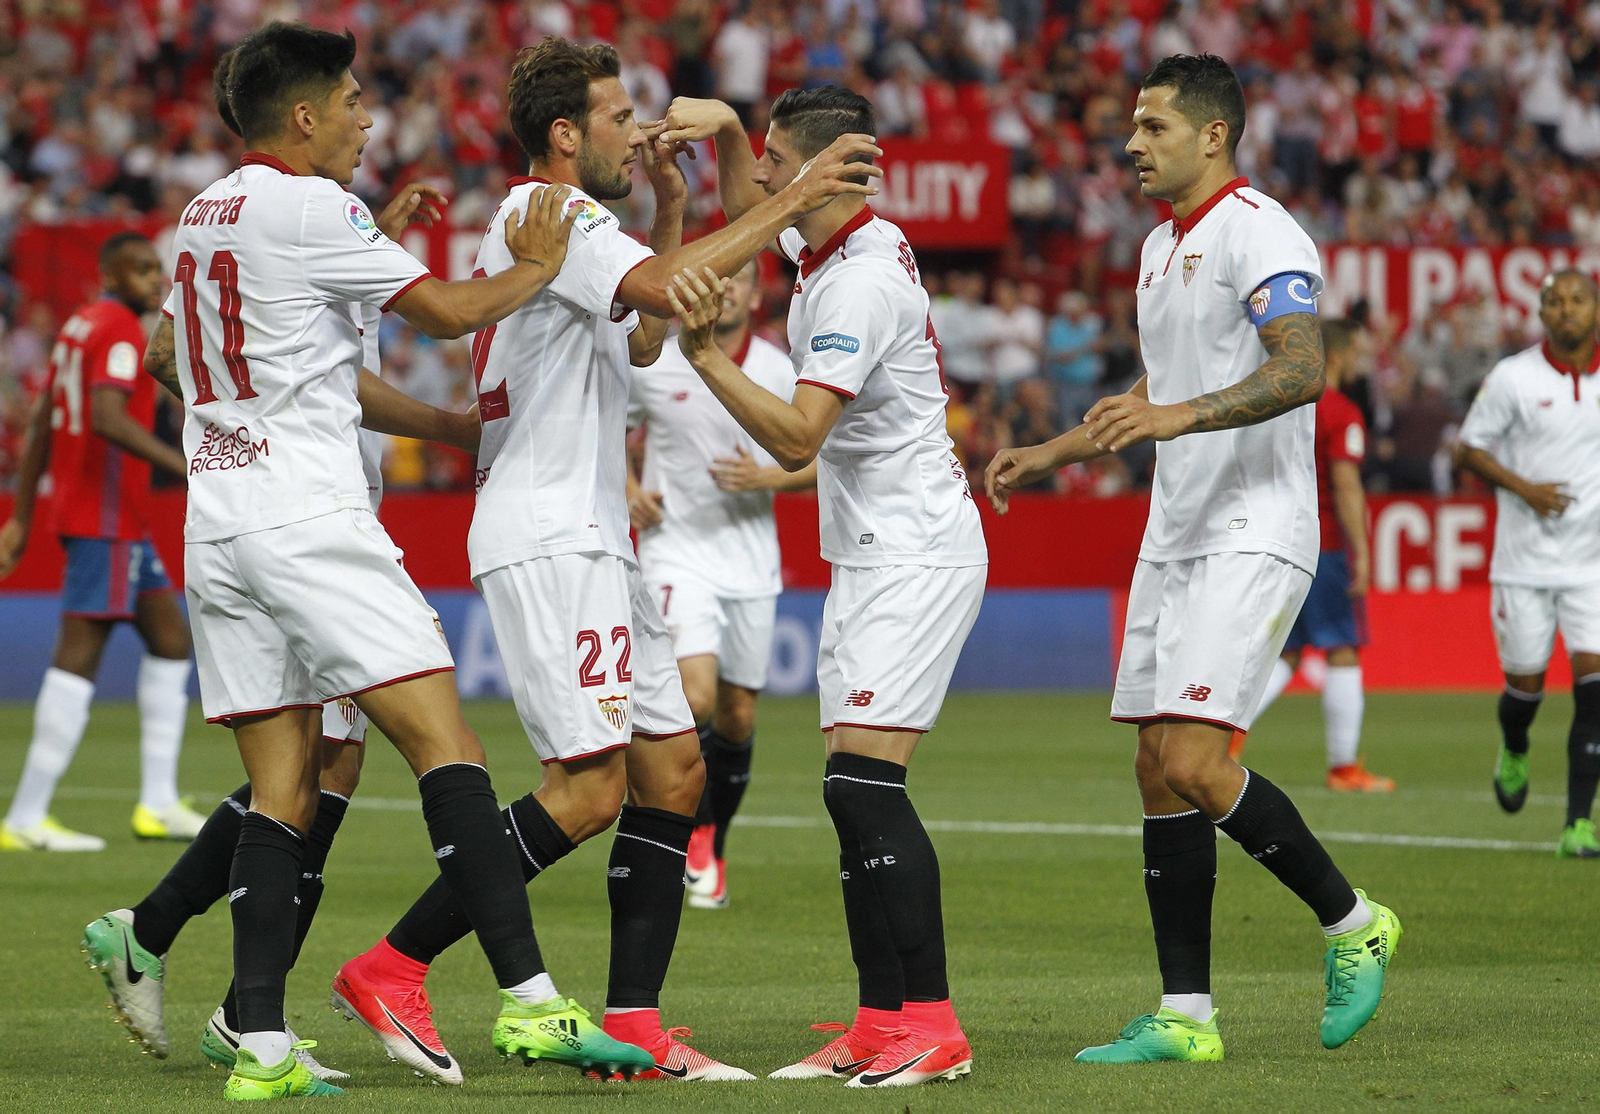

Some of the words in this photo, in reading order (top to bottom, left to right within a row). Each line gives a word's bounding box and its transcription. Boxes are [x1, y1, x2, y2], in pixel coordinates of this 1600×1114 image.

[367, 229, 384, 243] LaL
[583, 214, 612, 233] LaLiga
[174, 250, 260, 406] 11
[576, 625, 632, 688] 22
[538, 1022, 583, 1052] adidas
